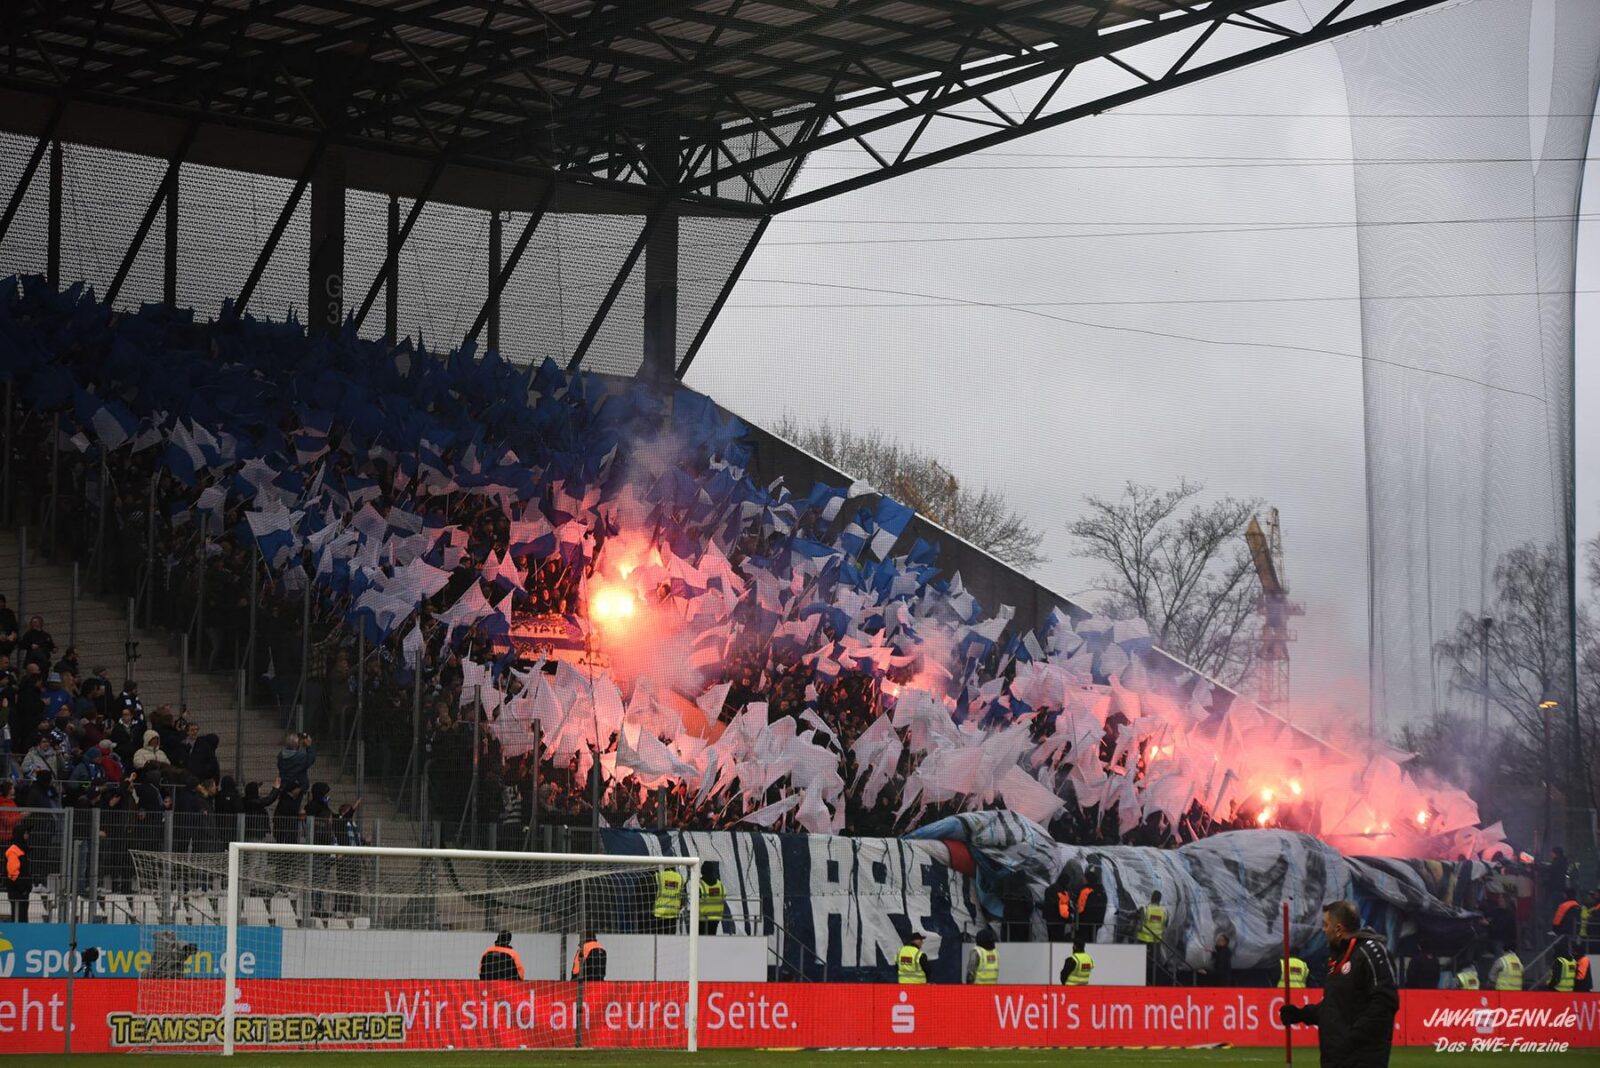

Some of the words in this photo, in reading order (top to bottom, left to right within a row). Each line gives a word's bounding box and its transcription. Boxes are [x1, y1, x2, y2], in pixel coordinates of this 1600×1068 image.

[326, 301, 340, 325] 3
[384, 990, 447, 1031] Wir
[459, 990, 534, 1030] sind
[549, 1001, 592, 1030] an
[706, 991, 798, 1030] Seite.
[993, 993, 1080, 1031] Weil's
[1091, 1003, 1134, 1031] um
[1144, 994, 1215, 1031] mehr
[1223, 994, 1260, 1031] als
